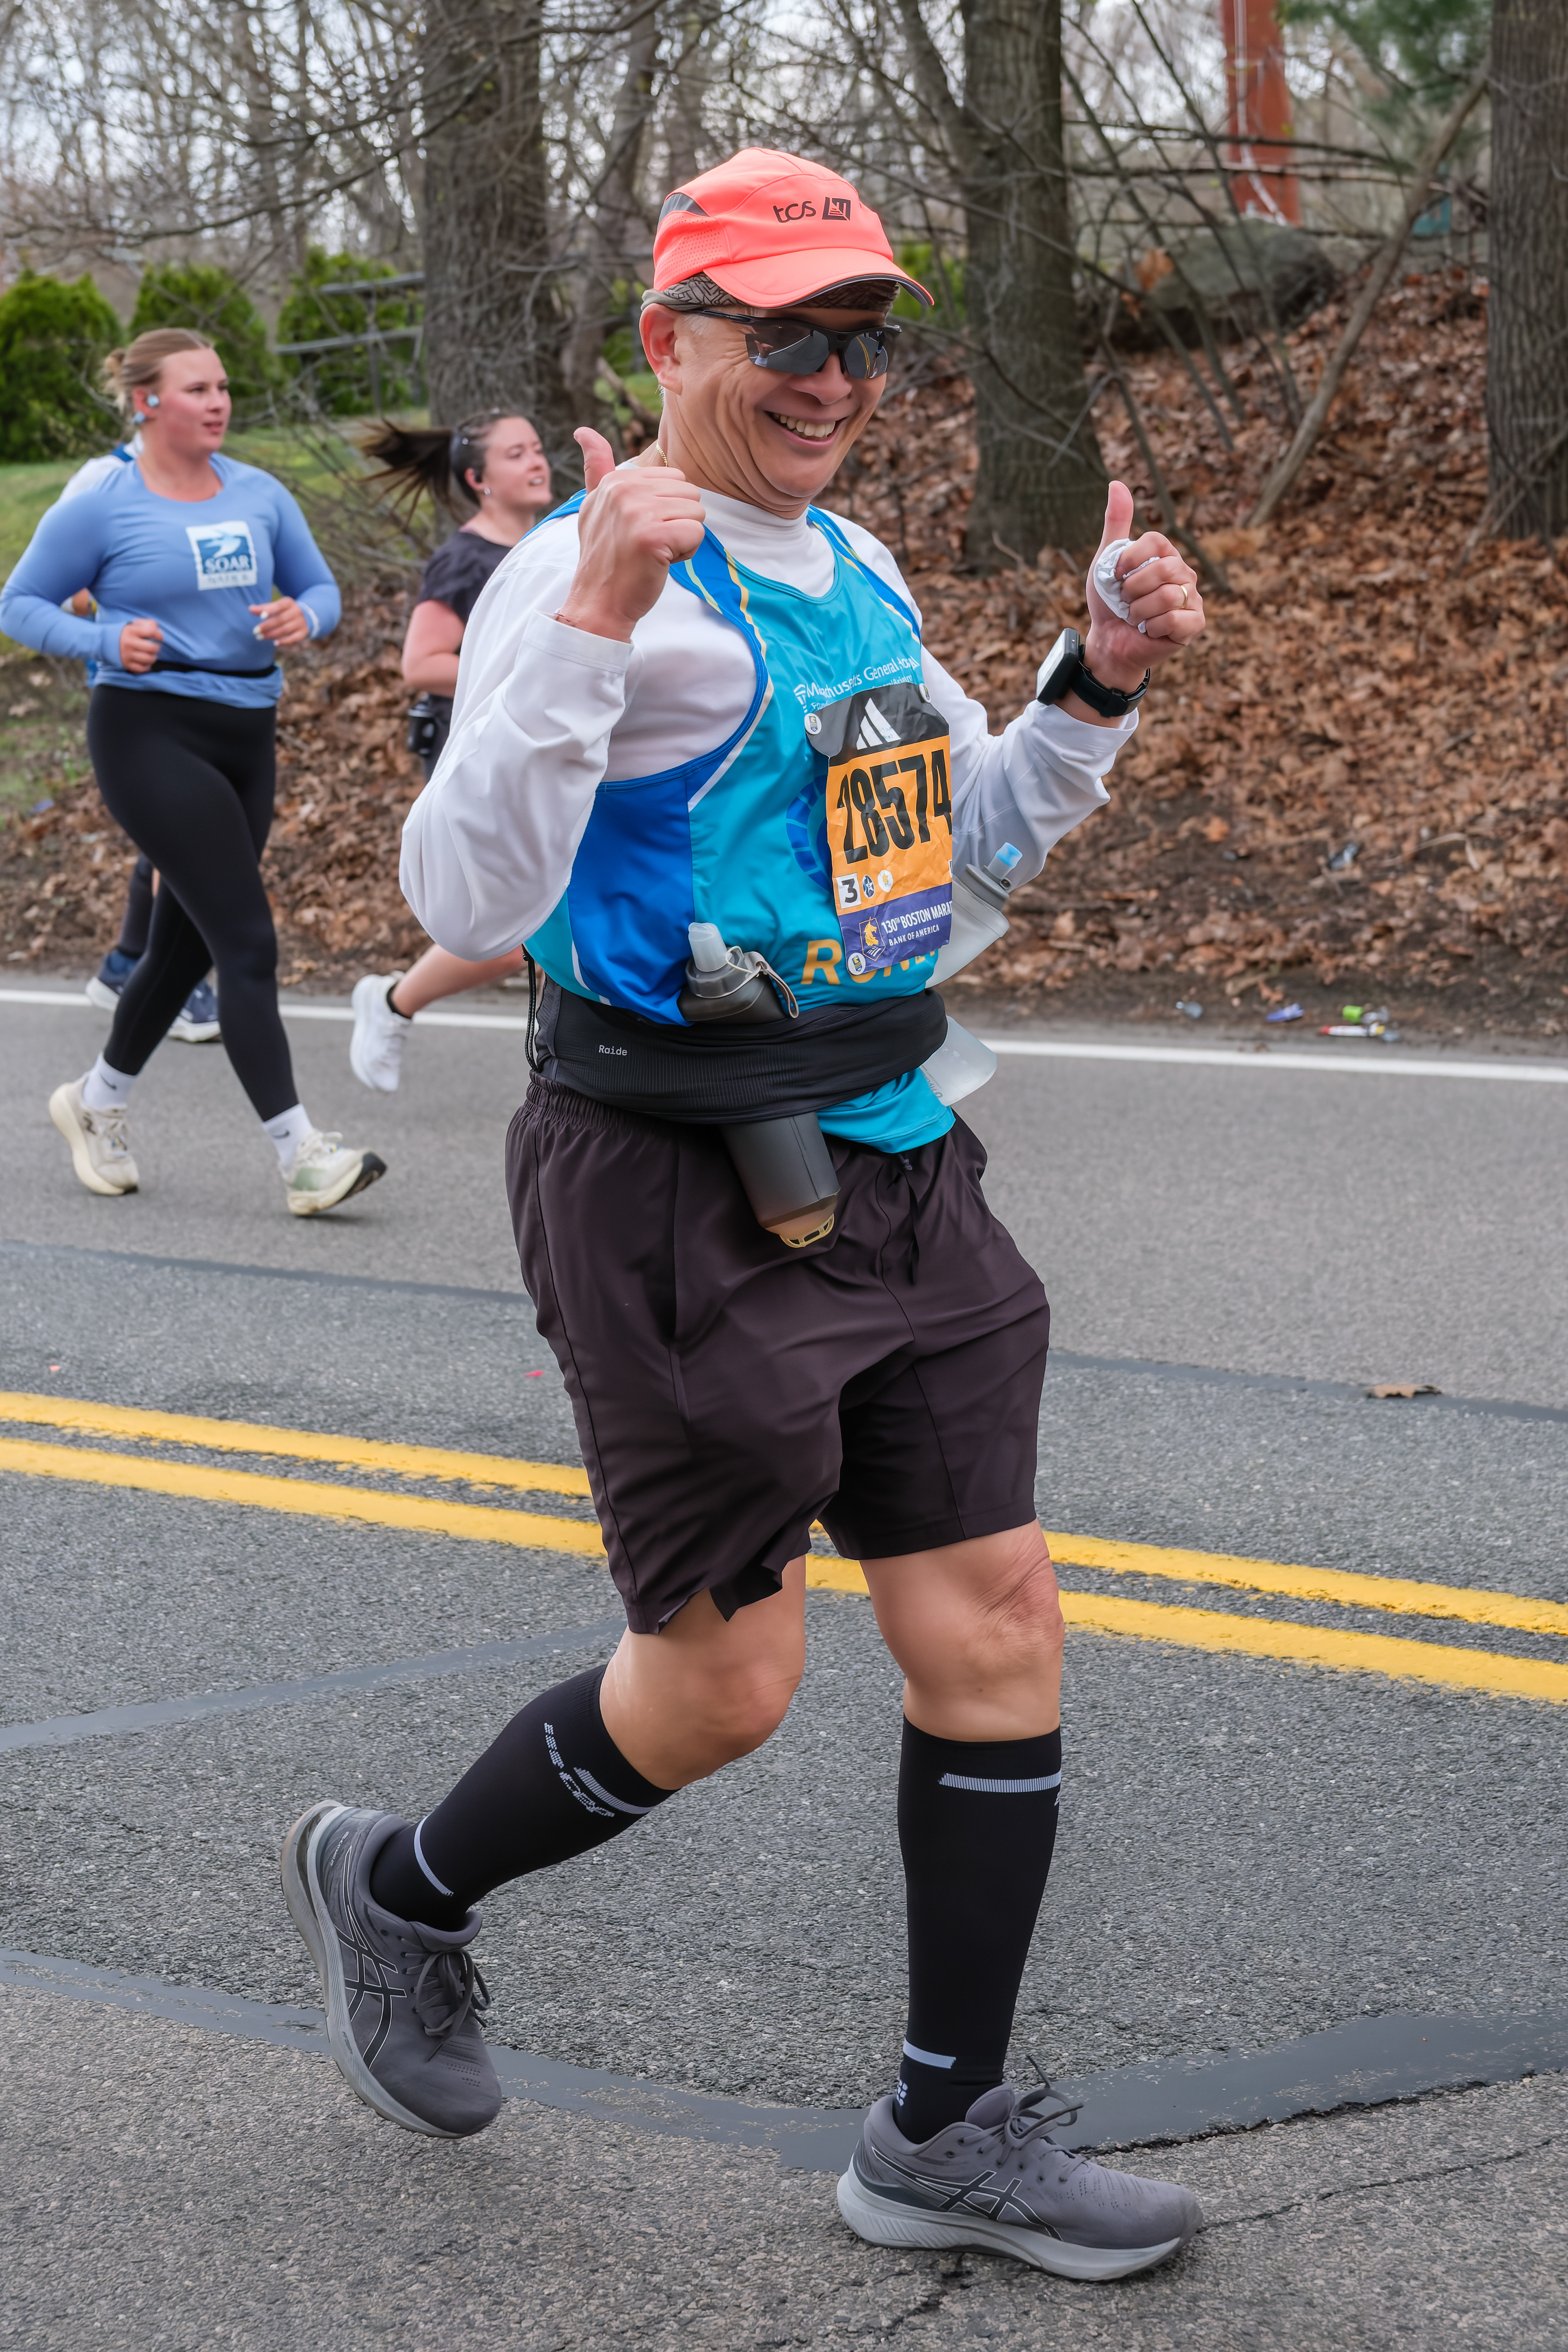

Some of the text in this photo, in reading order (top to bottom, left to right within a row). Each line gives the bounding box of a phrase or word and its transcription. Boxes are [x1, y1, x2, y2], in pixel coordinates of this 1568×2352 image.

[773, 200, 816, 223] tcs
[205, 554, 252, 573] SOAR
[863, 658, 900, 681] General
[837, 749, 952, 864] 28574
[841, 878, 858, 903] 3
[900, 908, 931, 929] BOSTON
[889, 934, 907, 946] BANK
[915, 924, 940, 938] AMERICA
[598, 1044, 628, 1056] Raide
